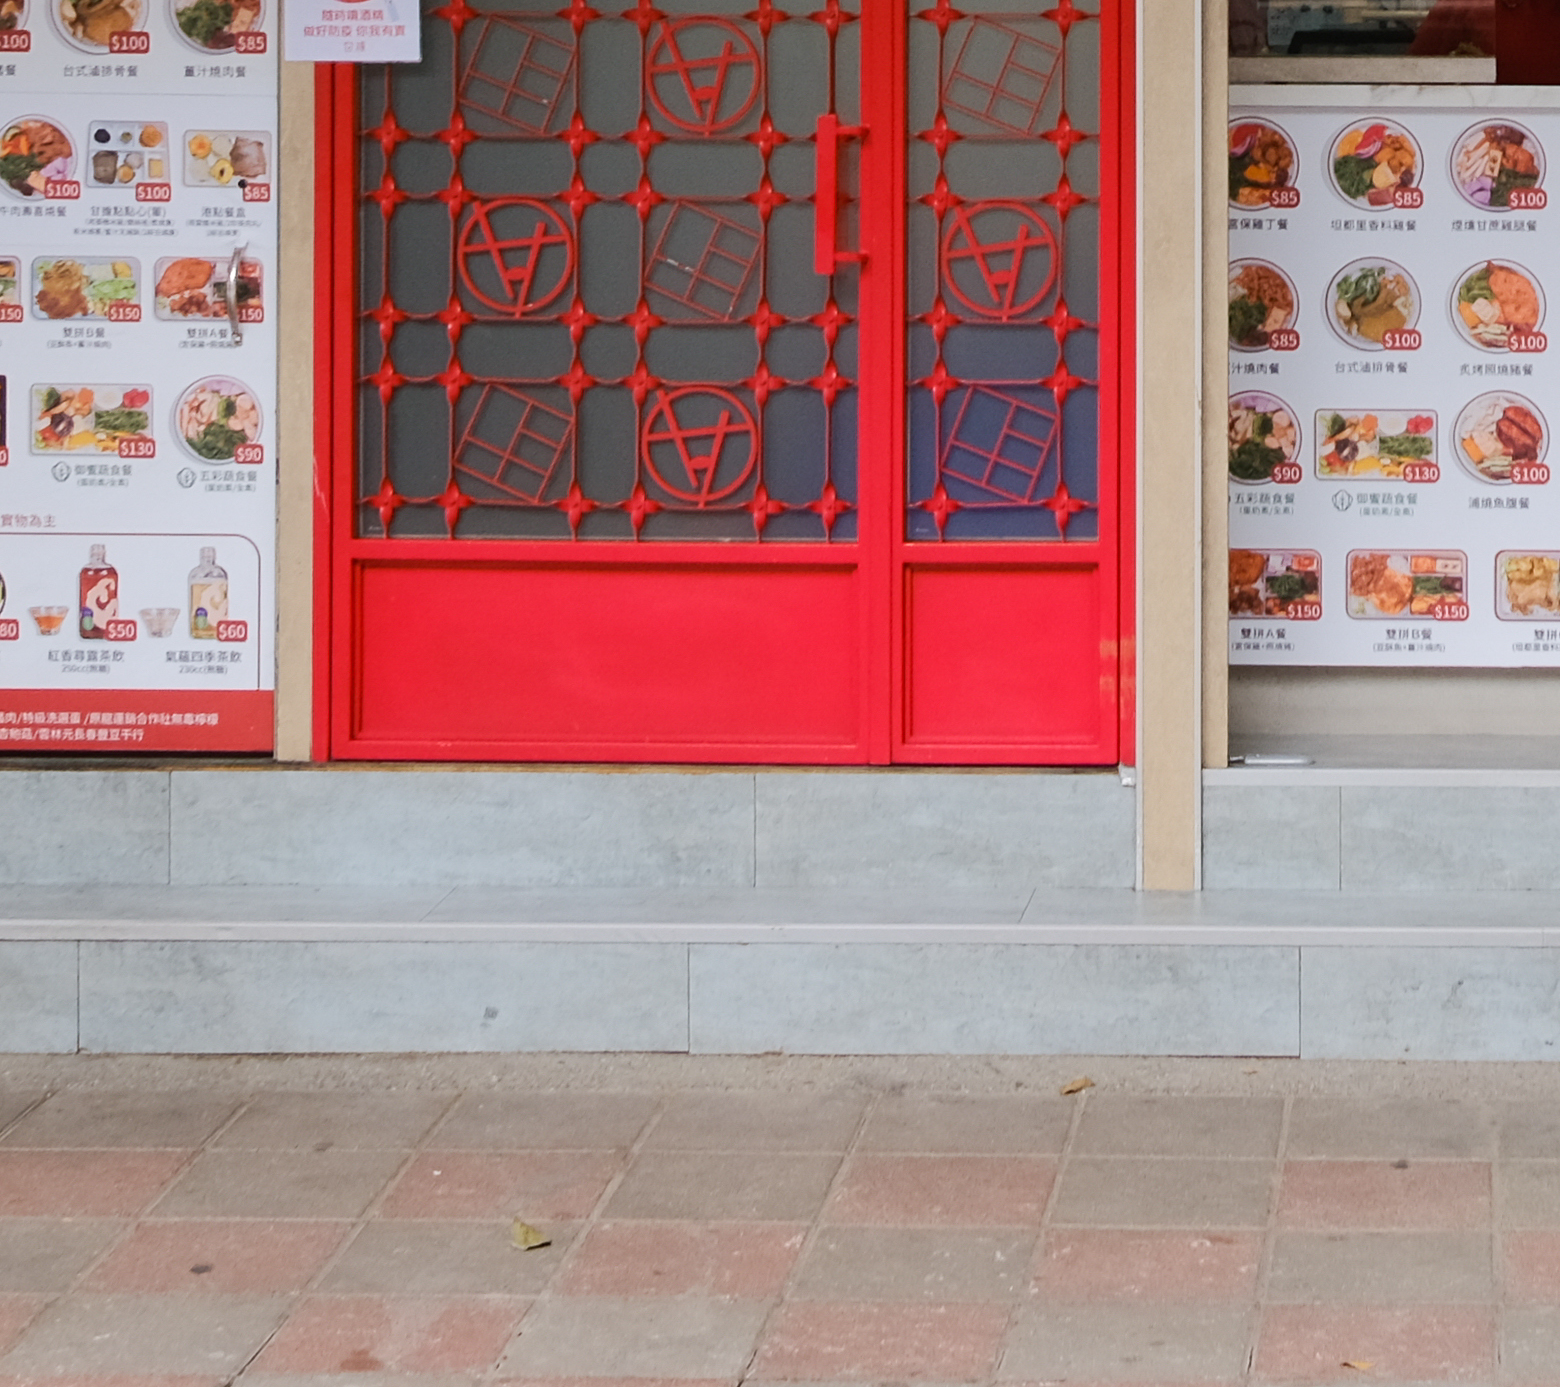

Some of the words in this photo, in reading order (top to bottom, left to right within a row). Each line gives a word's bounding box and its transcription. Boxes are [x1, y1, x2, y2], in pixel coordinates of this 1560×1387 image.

[110, 34, 149, 52] $100
[237, 35, 266, 52] $85
[45, 181, 80, 197] $100
[136, 184, 170, 200] $100
[243, 184, 270, 200] $85
[1270, 190, 1298, 206] $85
[1394, 191, 1422, 207] $85
[1509, 192, 1546, 208] $100
[108, 306, 140, 321] $150
[239, 306, 264, 321] 150
[1270, 333, 1298, 348] $85
[1384, 333, 1420, 349] $100
[1509, 335, 1546, 350] $100
[1229, 362, 1280, 376] 汁燒肉餐
[119, 441, 154, 456] $130
[235, 447, 262, 462] $90
[1272, 466, 1300, 481] $90
[1404, 466, 1440, 481] $130
[1512, 466, 1549, 482] $100
[1287, 605, 1321, 620] $150
[1434, 605, 1468, 620] $150
[107, 623, 136, 639] $50
[217, 623, 246, 640] $60
